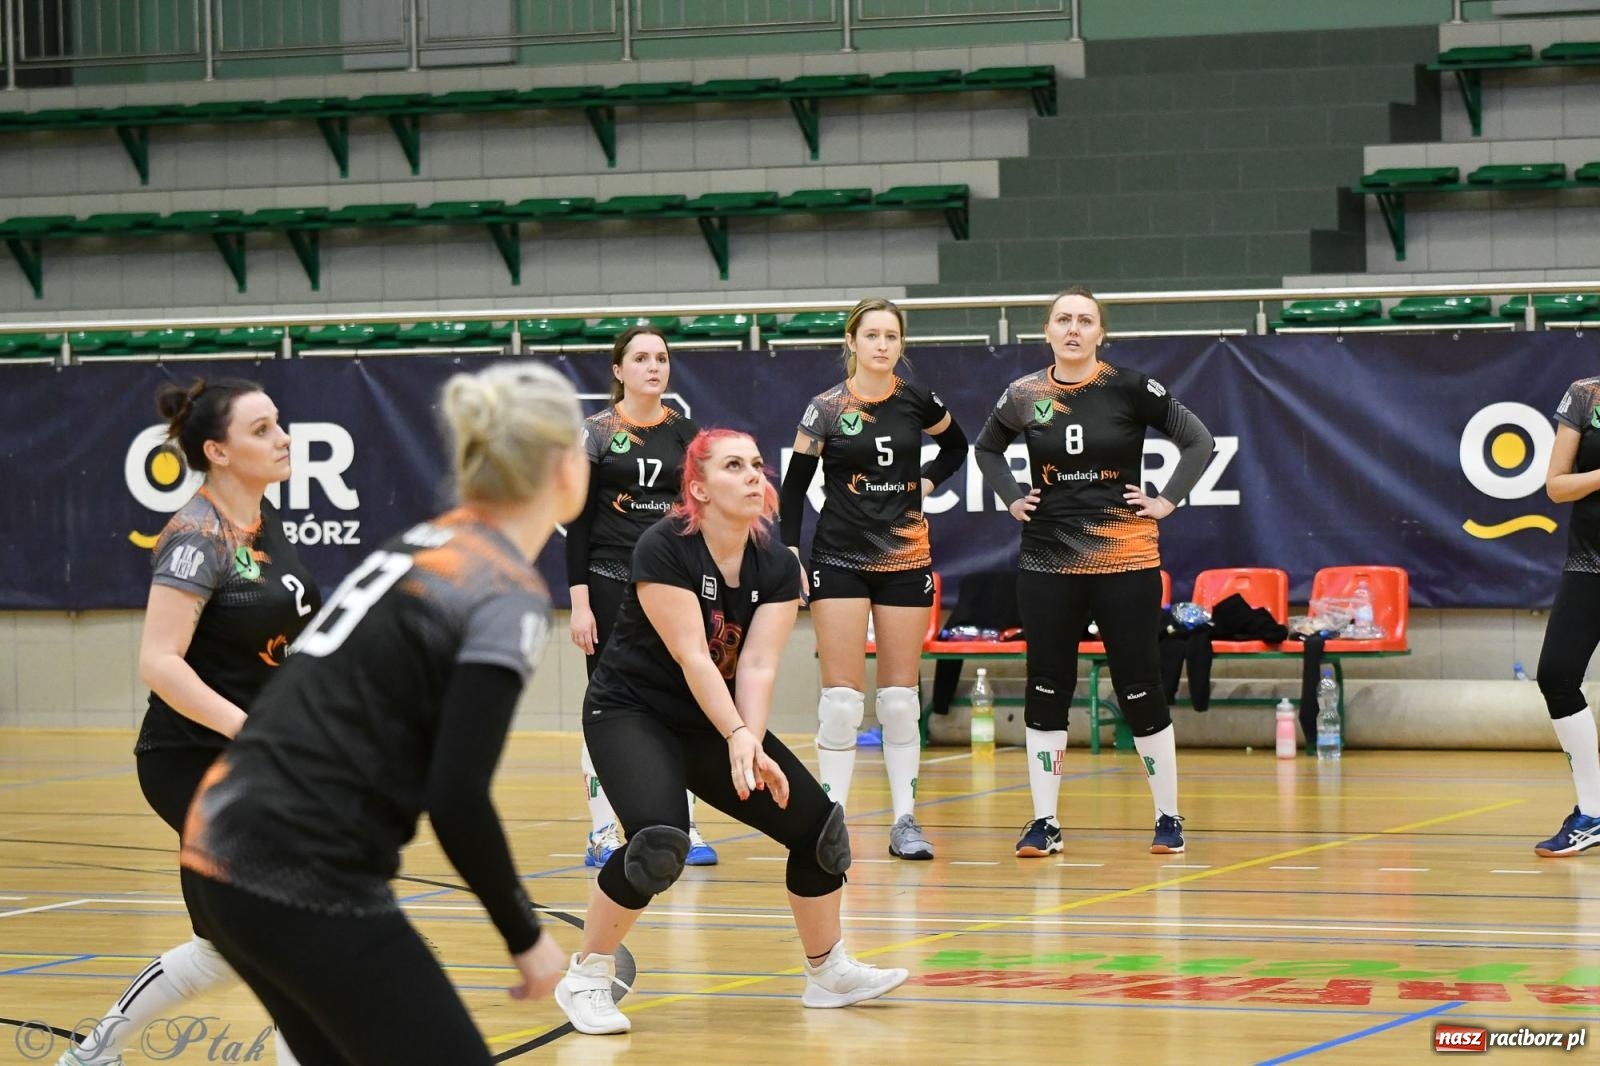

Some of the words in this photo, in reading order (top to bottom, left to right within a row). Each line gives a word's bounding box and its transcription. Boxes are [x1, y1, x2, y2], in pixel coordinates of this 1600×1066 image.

[875, 436, 894, 466] 5
[1065, 424, 1084, 455] 8
[636, 458, 663, 487] 17
[1057, 470, 1098, 482] Fundacja
[1100, 469, 1120, 480] JSW
[866, 482, 905, 493] Fundacja
[631, 500, 670, 512] Fundacja
[282, 514, 360, 545] BÓRZ
[813, 570, 820, 588] 5
[281, 573, 312, 617] 2
